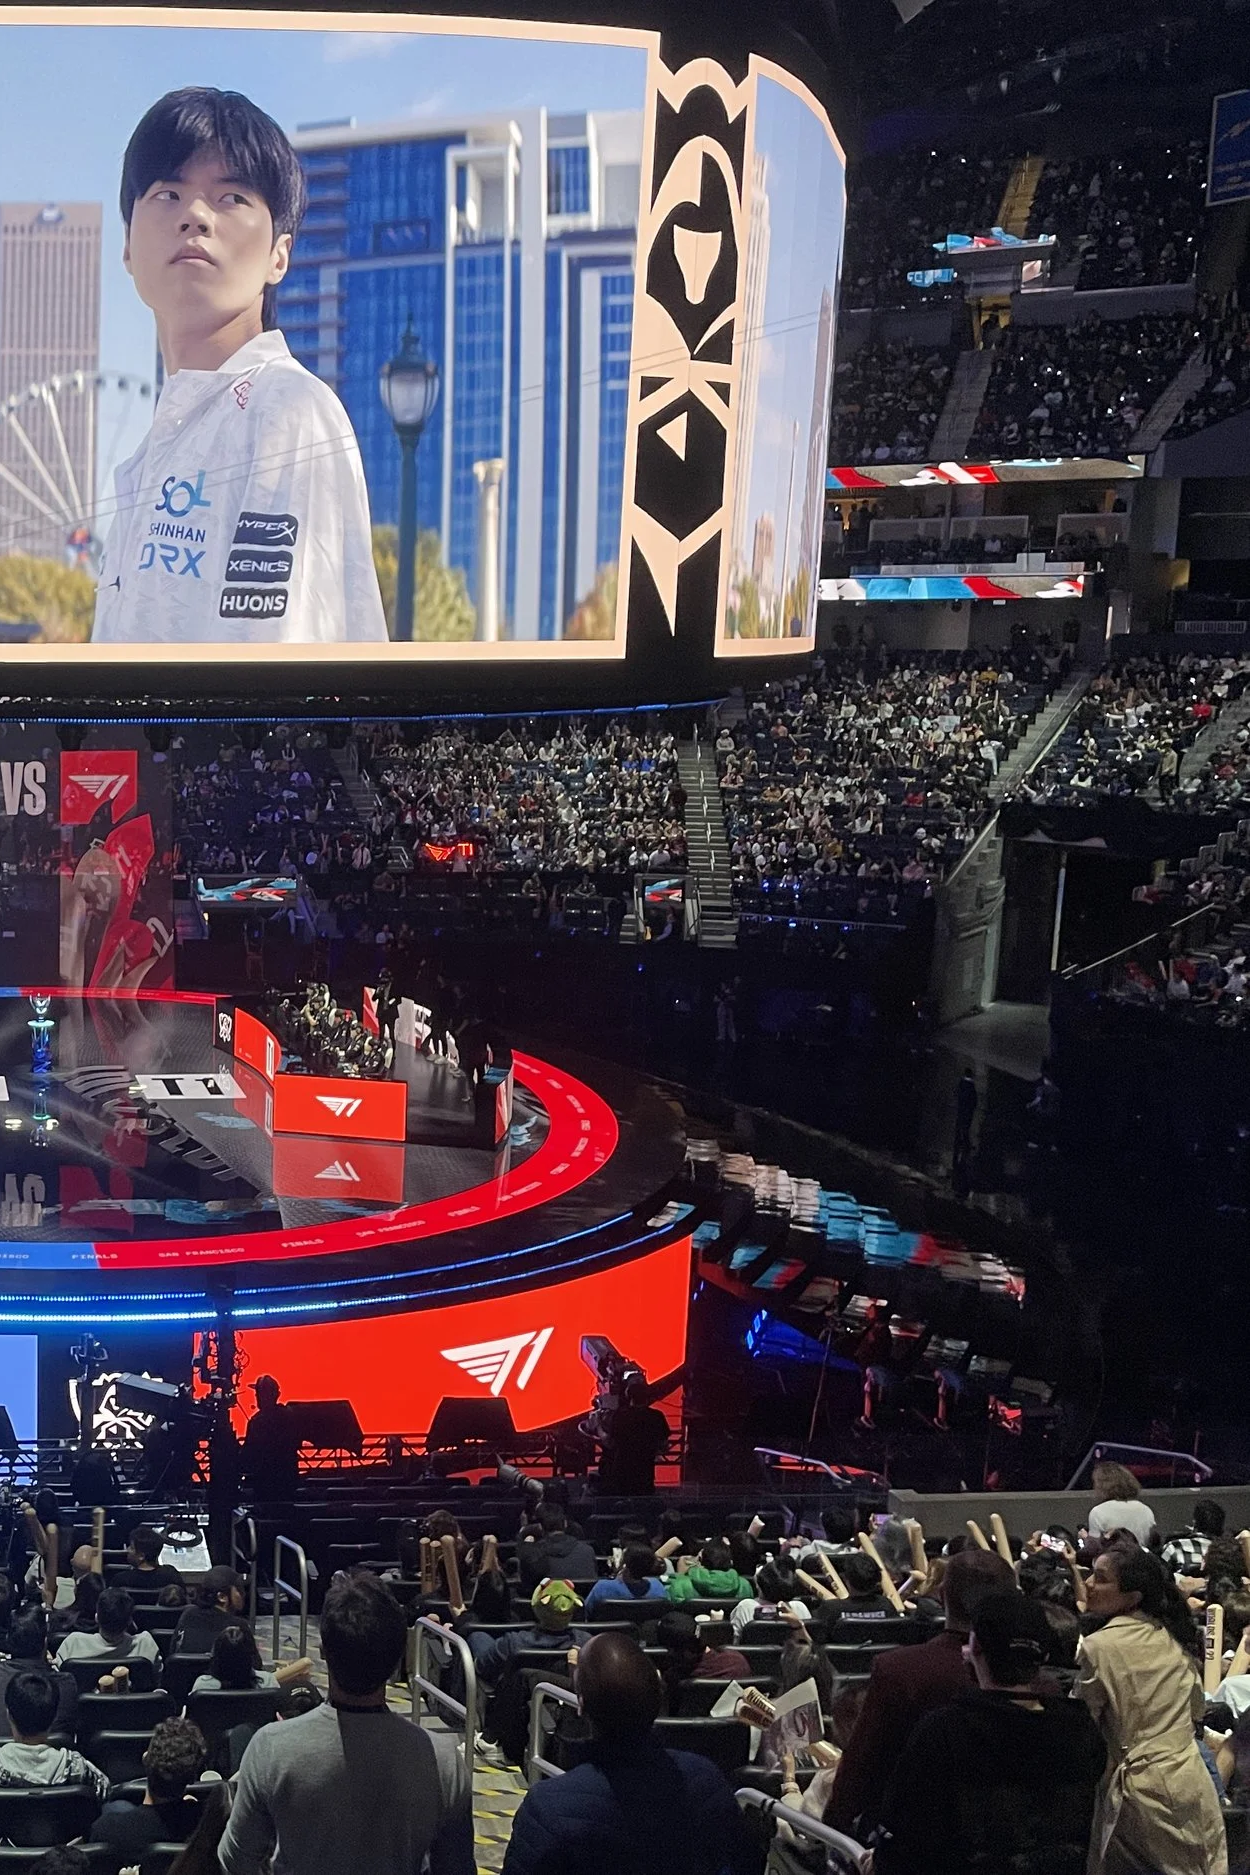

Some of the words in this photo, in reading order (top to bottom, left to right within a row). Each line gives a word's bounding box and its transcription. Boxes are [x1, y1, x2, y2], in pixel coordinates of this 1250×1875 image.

[155, 469, 211, 518] SOL
[149, 522, 206, 543] SHINHAN
[228, 559, 290, 573] XENICS
[221, 594, 286, 612] HUONS
[1, 761, 47, 816] VS
[151, 1077, 224, 1096] T1
[71, 1252, 119, 1260] FINALS
[185, 1246, 245, 1257] FRANCISCO
